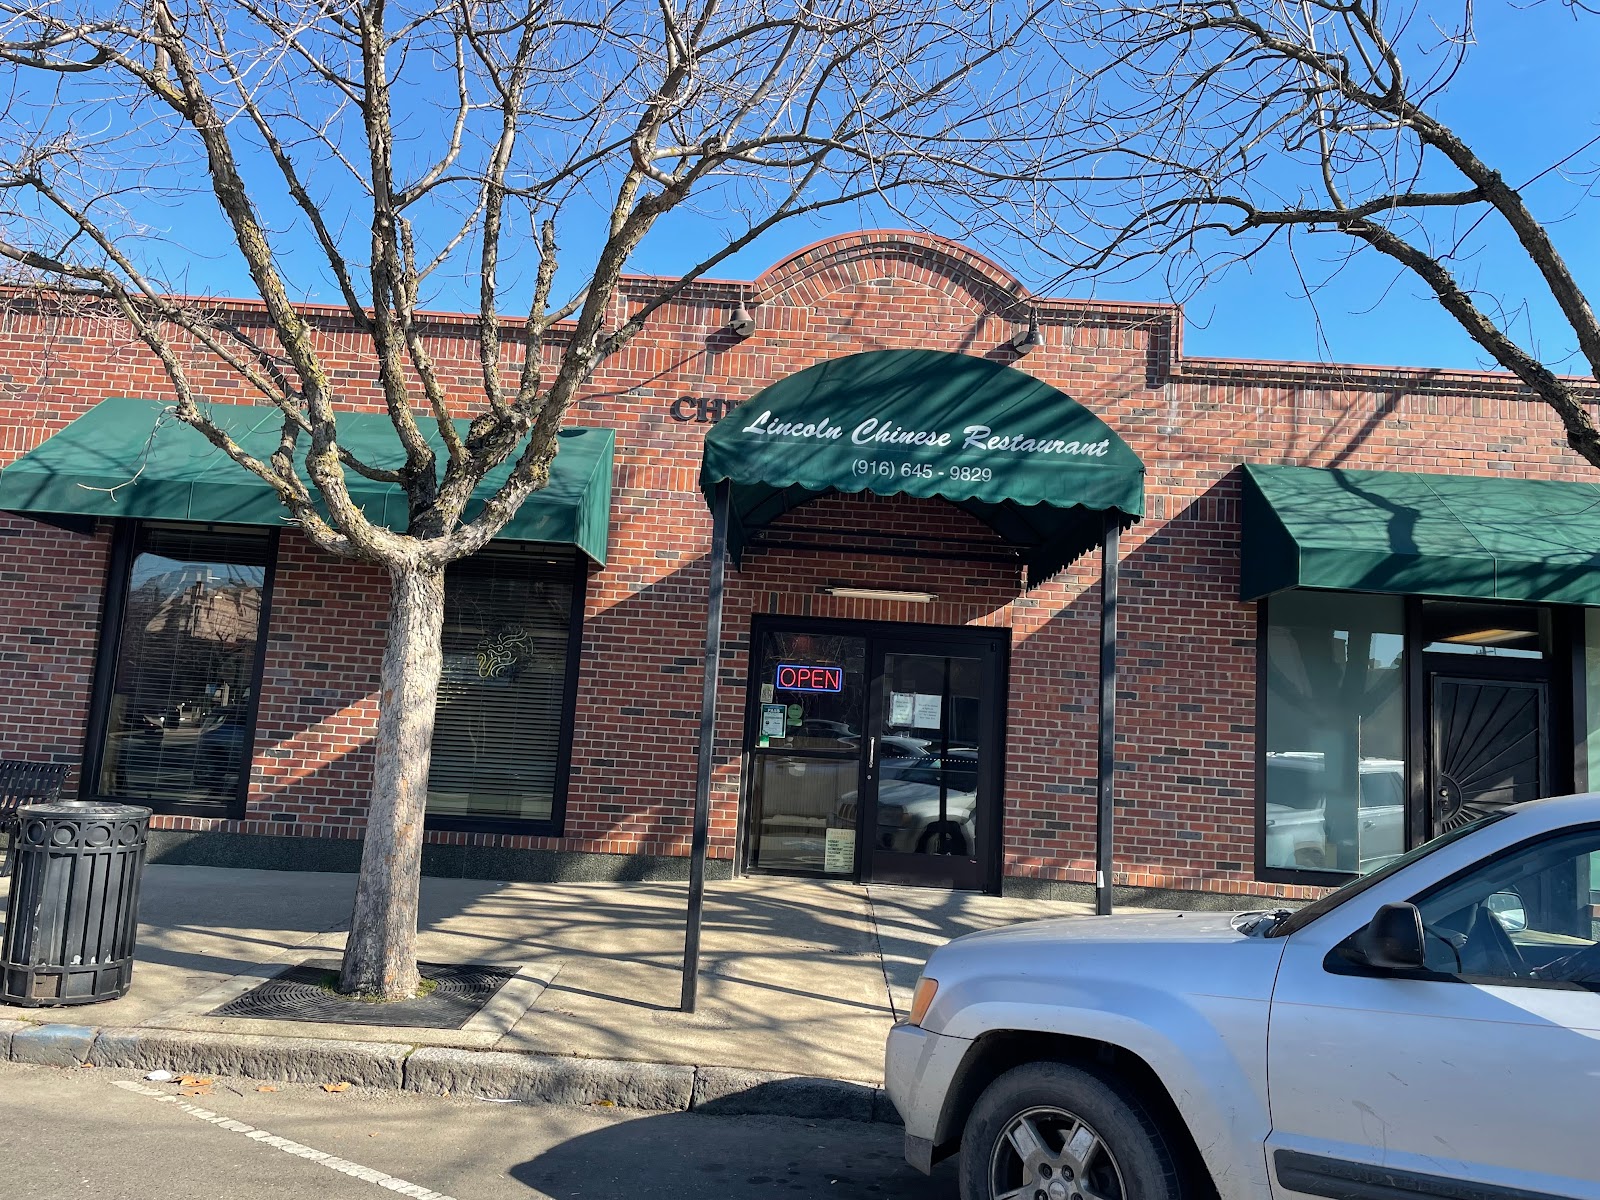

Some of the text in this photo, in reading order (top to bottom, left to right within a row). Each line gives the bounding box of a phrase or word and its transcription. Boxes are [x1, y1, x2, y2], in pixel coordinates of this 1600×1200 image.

[742, 410, 1110, 457] Lincoln Chinese Restaurant
[851, 459, 895, 479] (916)
[900, 462, 933, 478] 645
[949, 465, 992, 482] 9829
[780, 667, 839, 690] OPEN
